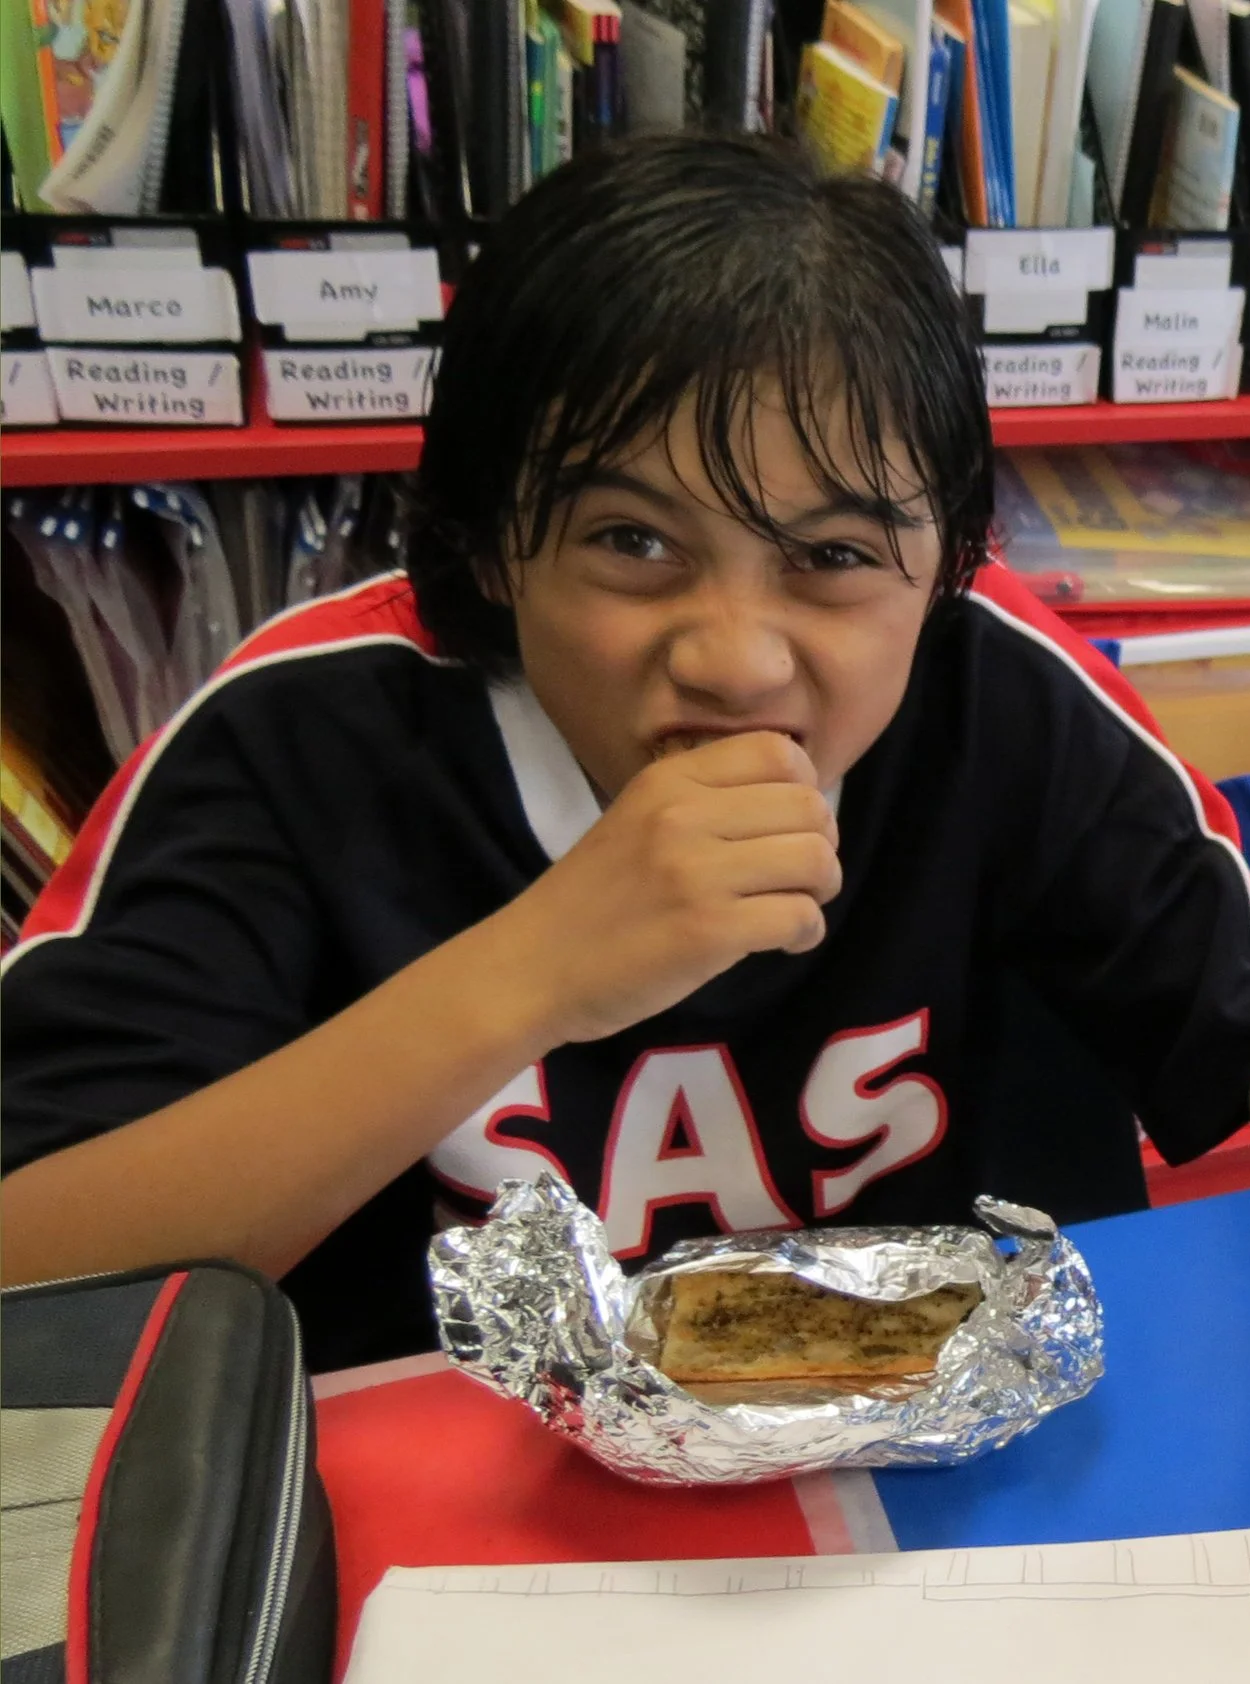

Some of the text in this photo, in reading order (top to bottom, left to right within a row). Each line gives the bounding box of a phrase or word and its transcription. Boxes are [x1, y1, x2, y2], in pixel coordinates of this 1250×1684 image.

[319, 279, 378, 302] Amy
[87, 296, 182, 317] Marco
[1143, 312, 1199, 331] Malin
[66, 358, 188, 388] Reading
[279, 359, 392, 382] Reading
[1121, 352, 1200, 373] Reading
[994, 382, 1071, 401] Writing
[1135, 378, 1208, 397] Writing
[93, 391, 205, 419] Writing
[305, 390, 409, 412] Writing
